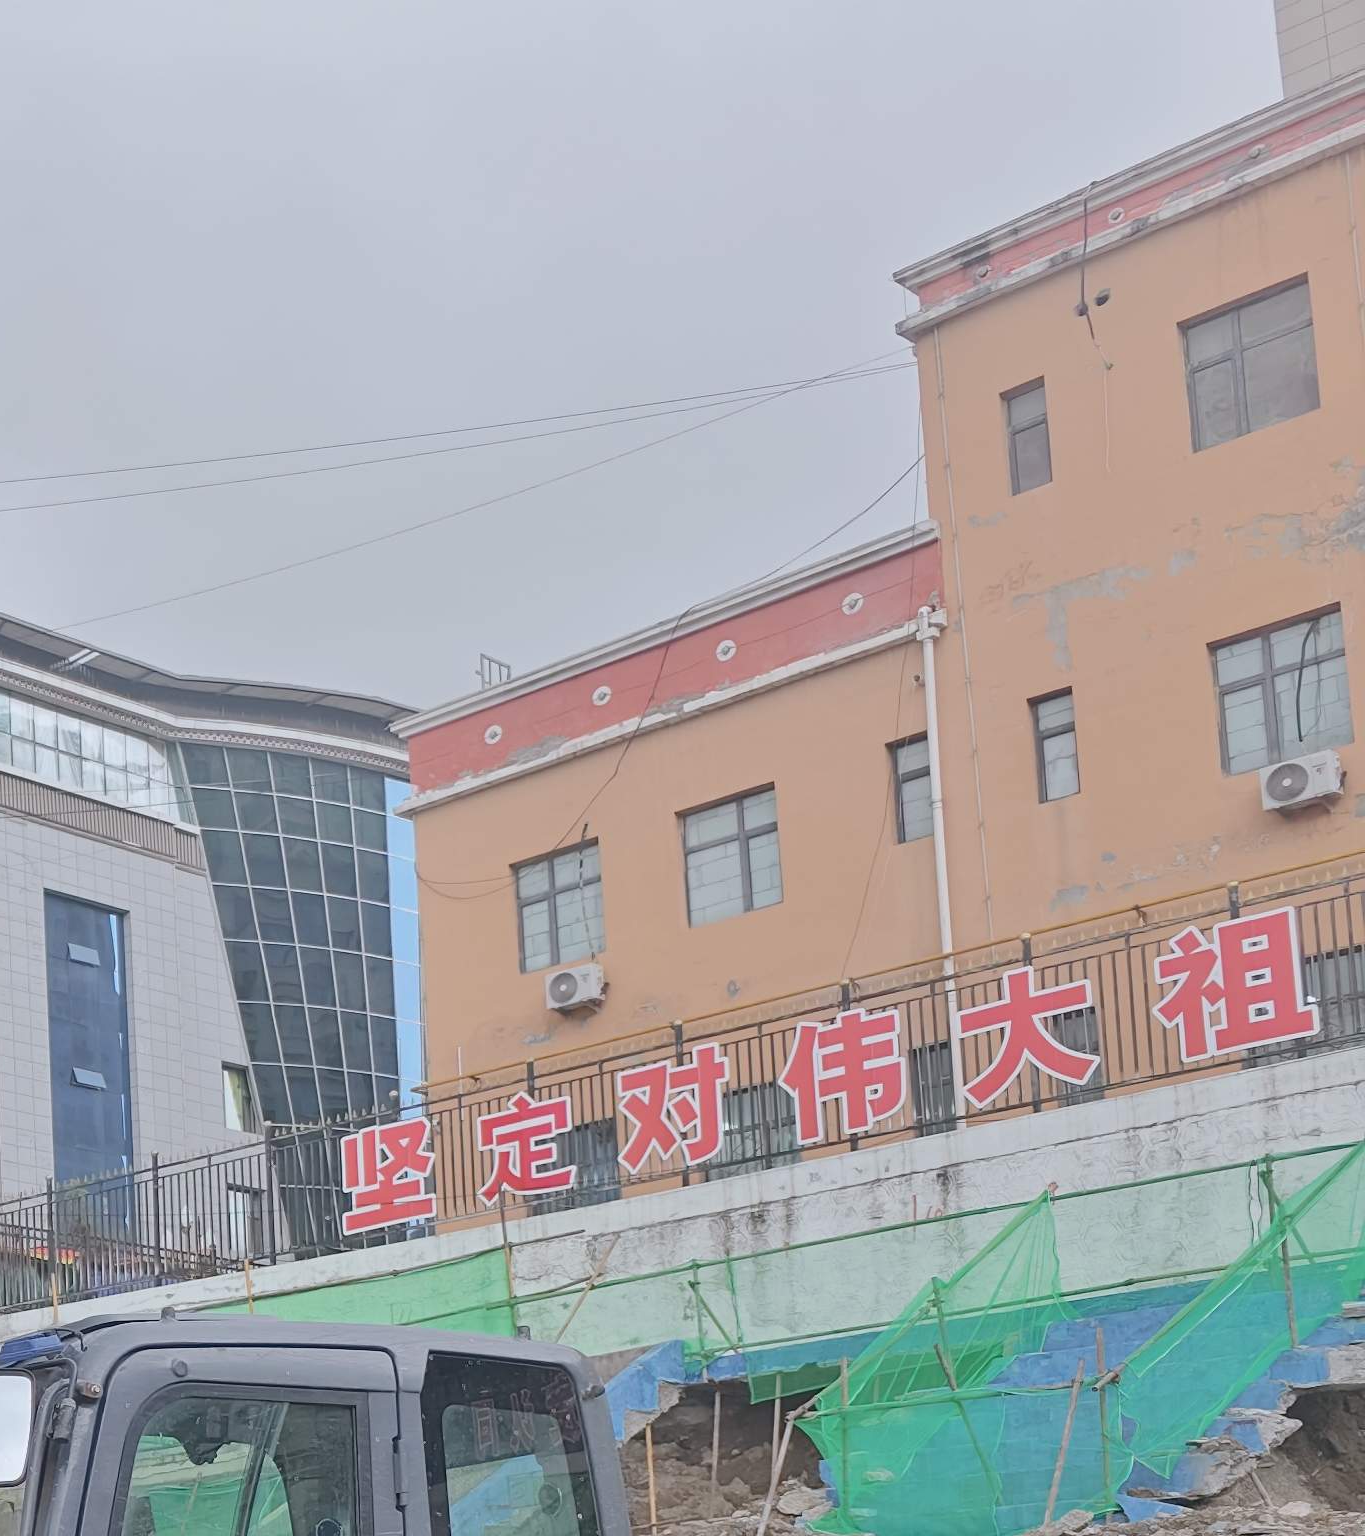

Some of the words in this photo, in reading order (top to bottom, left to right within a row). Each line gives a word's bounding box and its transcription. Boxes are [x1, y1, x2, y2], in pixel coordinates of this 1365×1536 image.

[340, 906, 1320, 1236] 坚定对伟大祖
